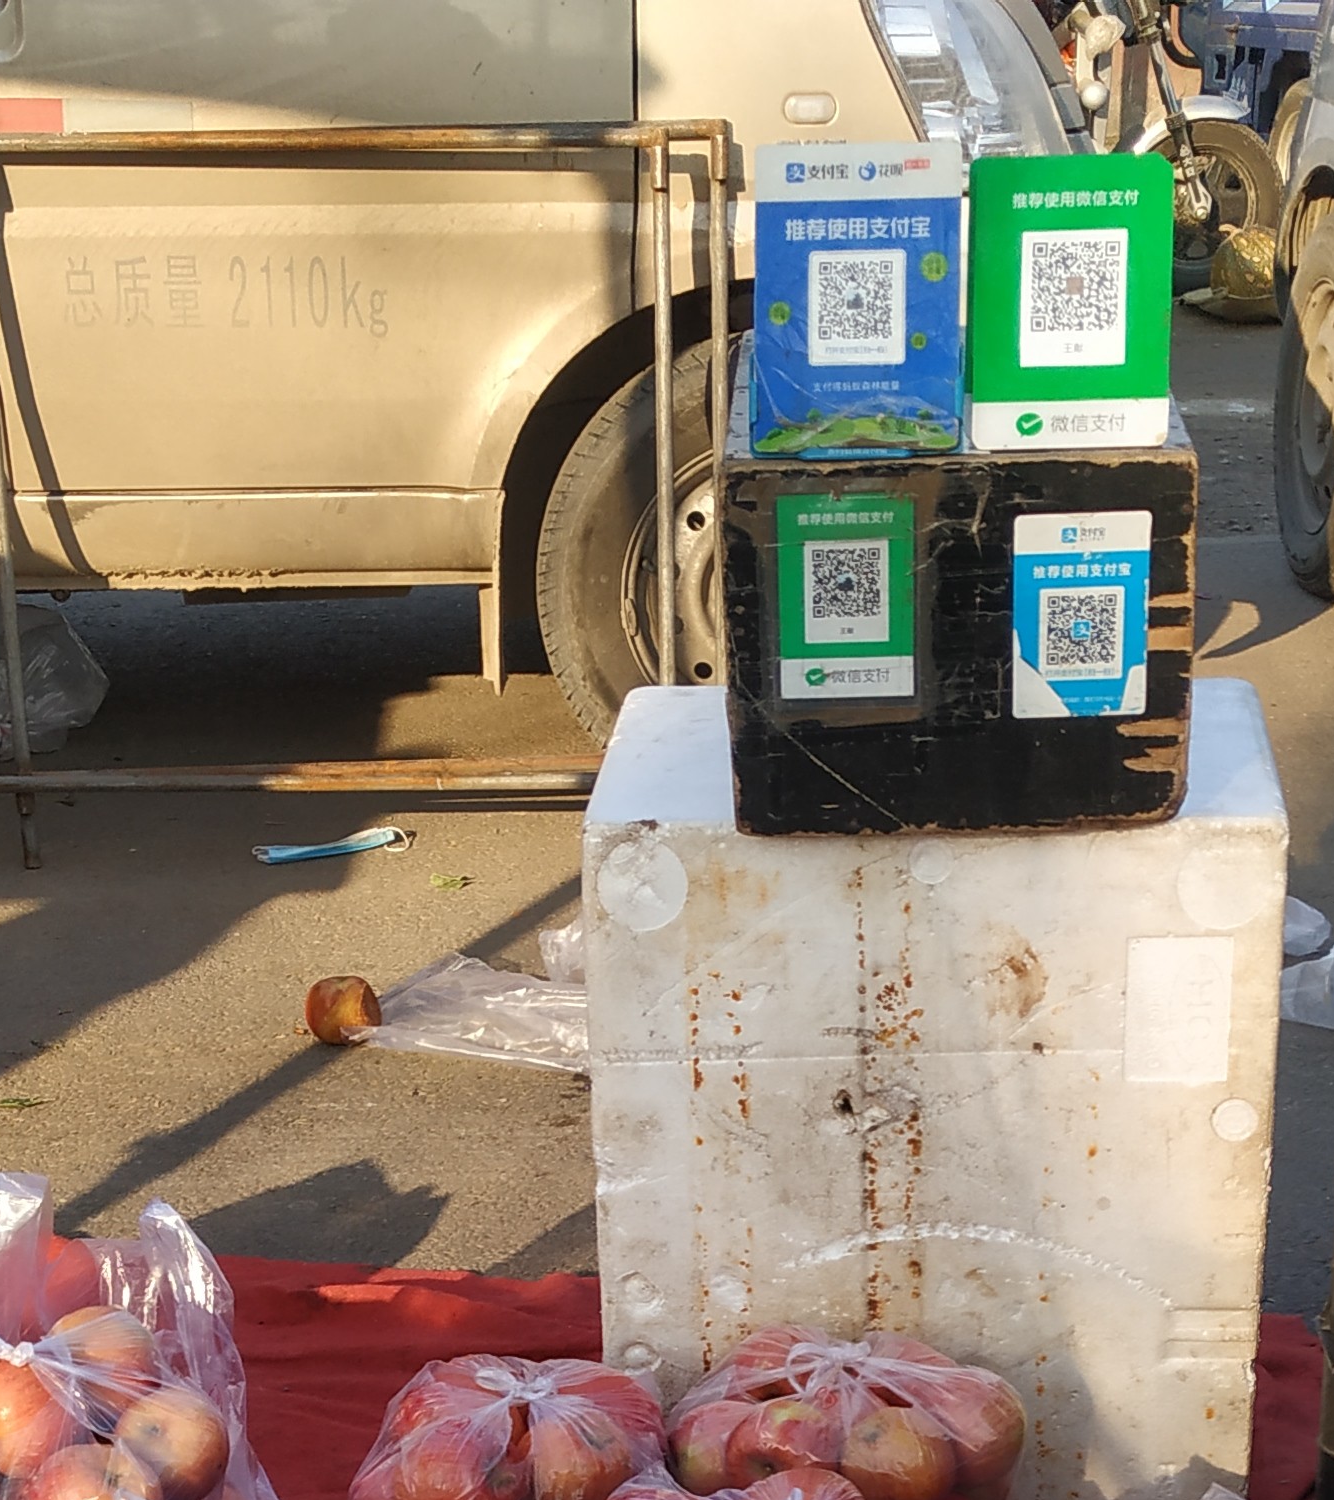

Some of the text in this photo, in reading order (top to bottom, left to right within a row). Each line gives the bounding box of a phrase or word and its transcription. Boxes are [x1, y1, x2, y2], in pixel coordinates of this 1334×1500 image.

[807, 163, 850, 180] 支付宝
[1013, 189, 1140, 208] 推荐使用微信支付
[785, 216, 932, 241] 推荐使用支付宝
[63, 253, 390, 337] 总质量 2110kg
[1050, 412, 1126, 433] 微信支付
[796, 510, 895, 527] 推荐使用微信支付
[1033, 562, 1132, 579] 推荐使用支付宝
[831, 667, 890, 684] 微信支付
